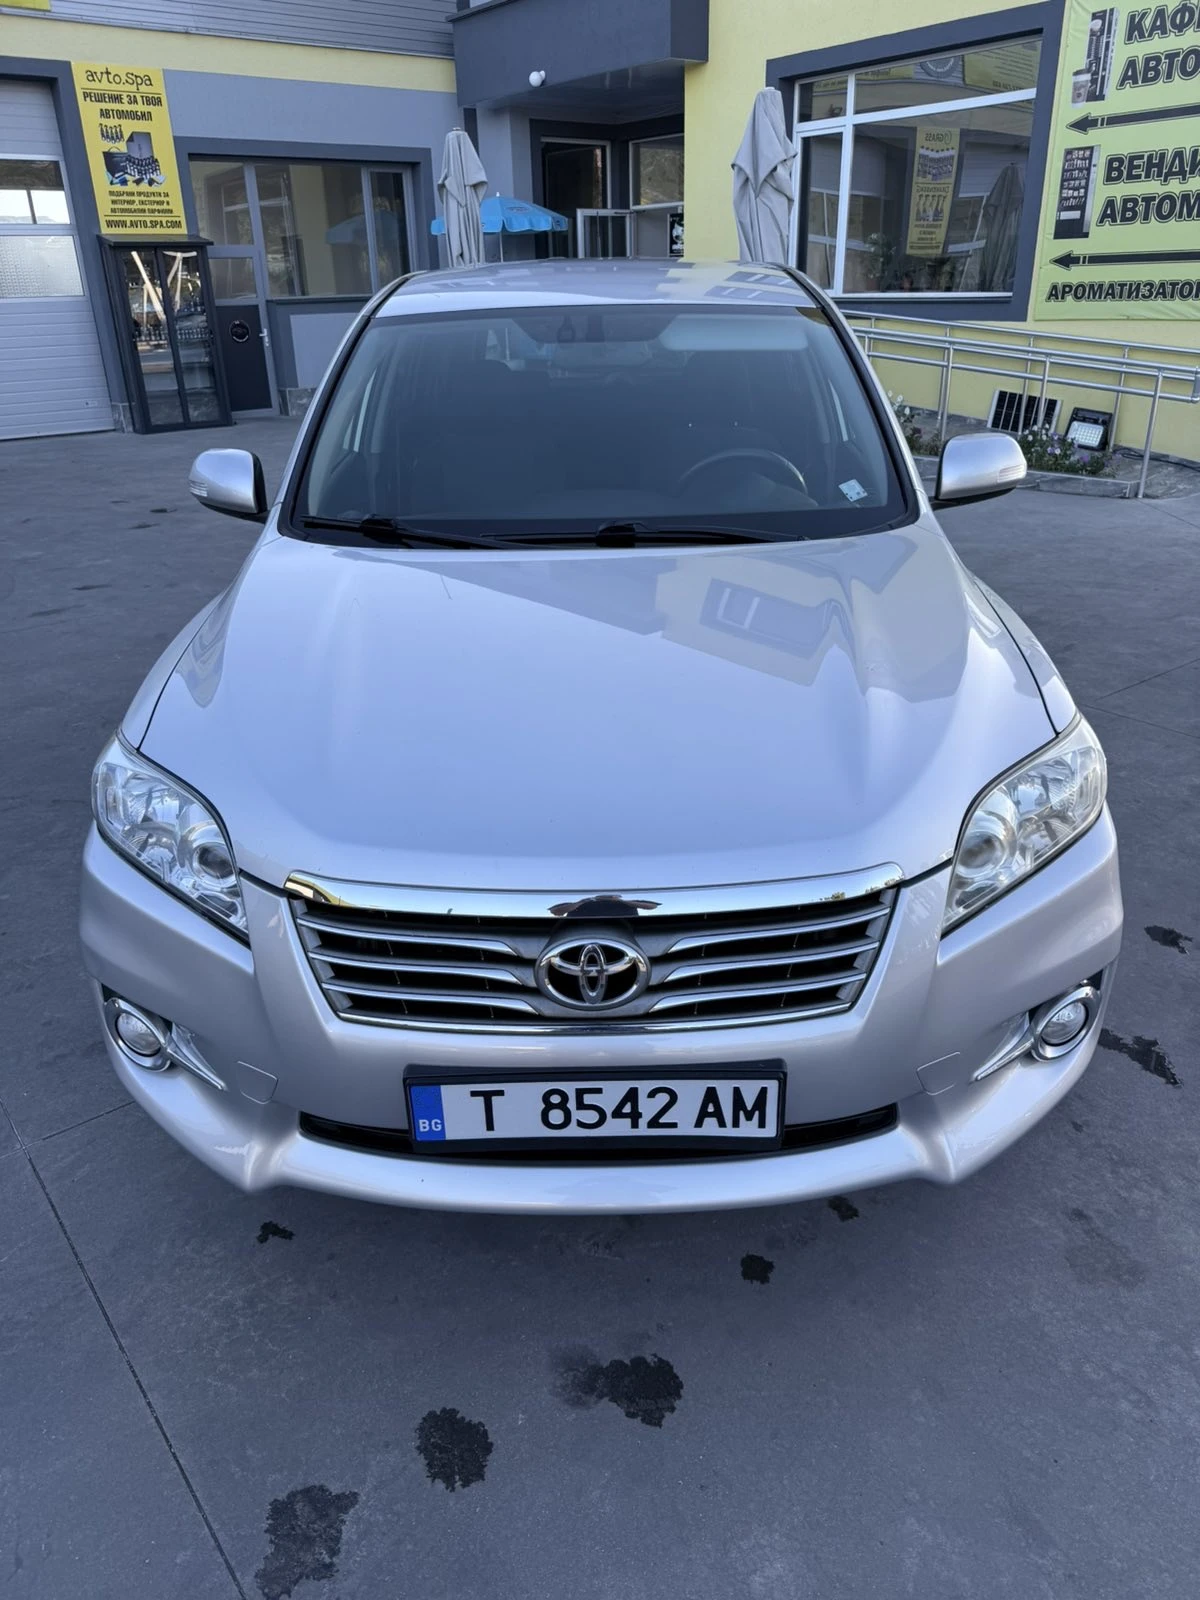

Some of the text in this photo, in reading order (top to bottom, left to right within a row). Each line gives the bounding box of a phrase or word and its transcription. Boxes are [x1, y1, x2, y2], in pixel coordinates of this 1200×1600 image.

[1124, 0, 1200, 44] КАФ
[85, 67, 153, 91] avto.spa
[1117, 45, 1200, 90] АВТО
[82, 91, 163, 107] РЕШЕНИЕ ЗА ТВОЯ
[99, 108, 153, 122] АВТОМОБИЛ
[1097, 190, 1200, 226] АВТОМ
[105, 219, 182, 230] WWW.AVTO.SPA.COM
[470, 1086, 768, 1132] T 8542 AM
[418, 1119, 442, 1132] BG
